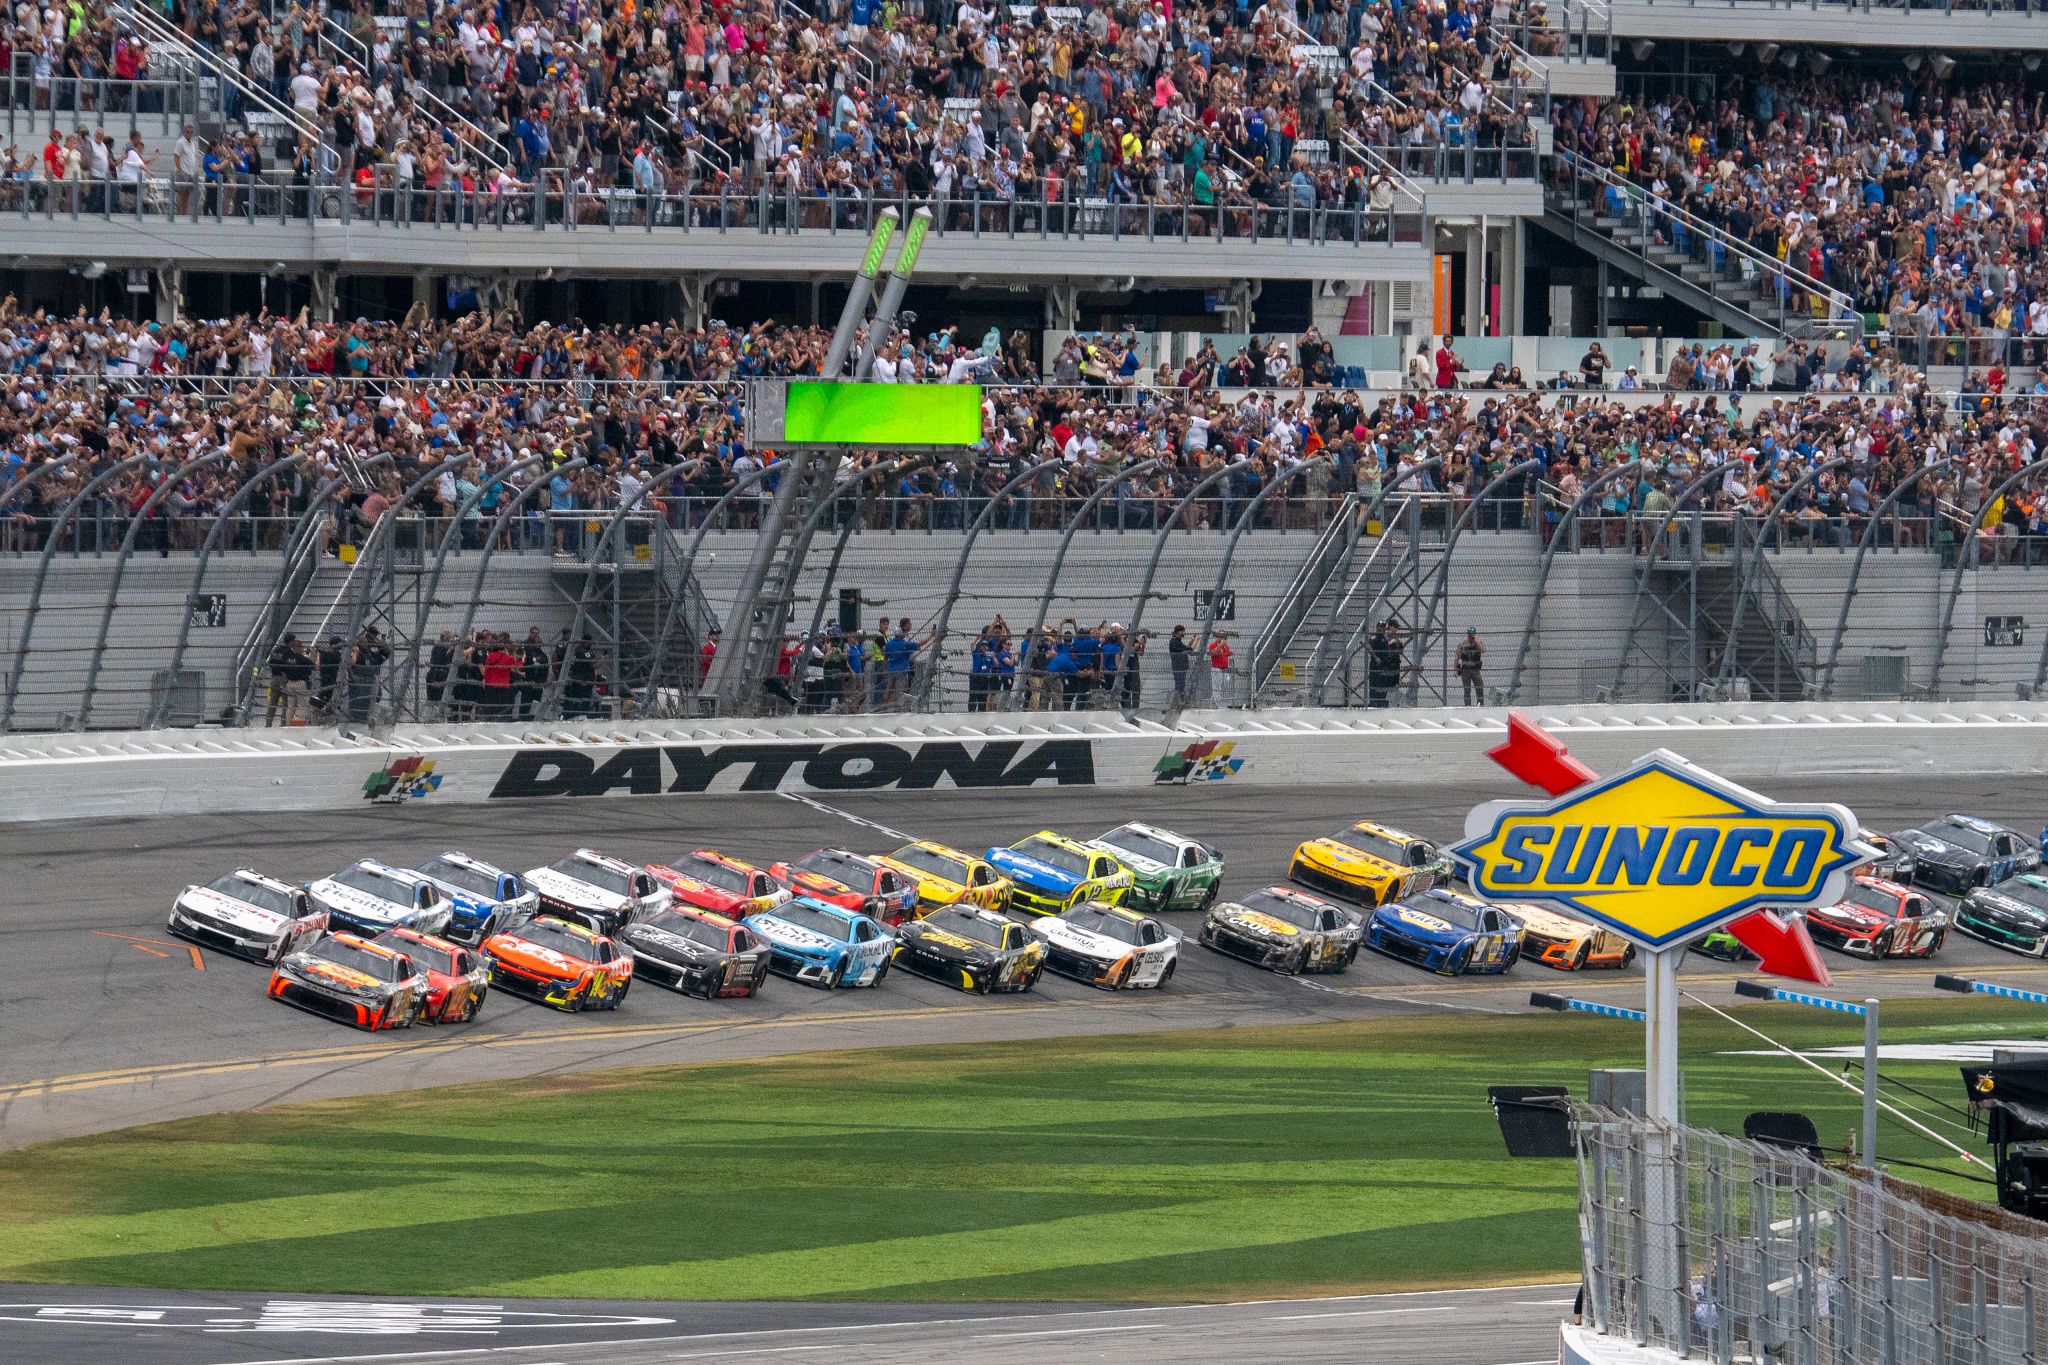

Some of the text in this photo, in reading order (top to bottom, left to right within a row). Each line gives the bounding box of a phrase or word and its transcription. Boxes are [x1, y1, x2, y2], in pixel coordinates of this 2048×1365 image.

[488, 740, 1096, 798] DAYTONA
[1490, 825, 1827, 887] SUNOCO
[602, 866, 628, 878] HAMLIN
[1175, 873, 1192, 898] 42
[320, 887, 390, 917] Health
[1292, 901, 1315, 913] DILLON
[1451, 902, 1475, 913] ELLIOTT
[819, 910, 850, 925] CHASTAIN
[1228, 917, 1272, 936] CLUB
[1407, 909, 1444, 928] NAPA
[1050, 929, 1097, 949] CELSIUS
[1311, 934, 1325, 961] 3
[421, 943, 449, 956] WALLACE
[915, 949, 947, 962] CAMRY
[1145, 951, 1165, 964] CELSIUS
[1472, 936, 1489, 962] 9
[305, 982, 341, 997] CAMRY
